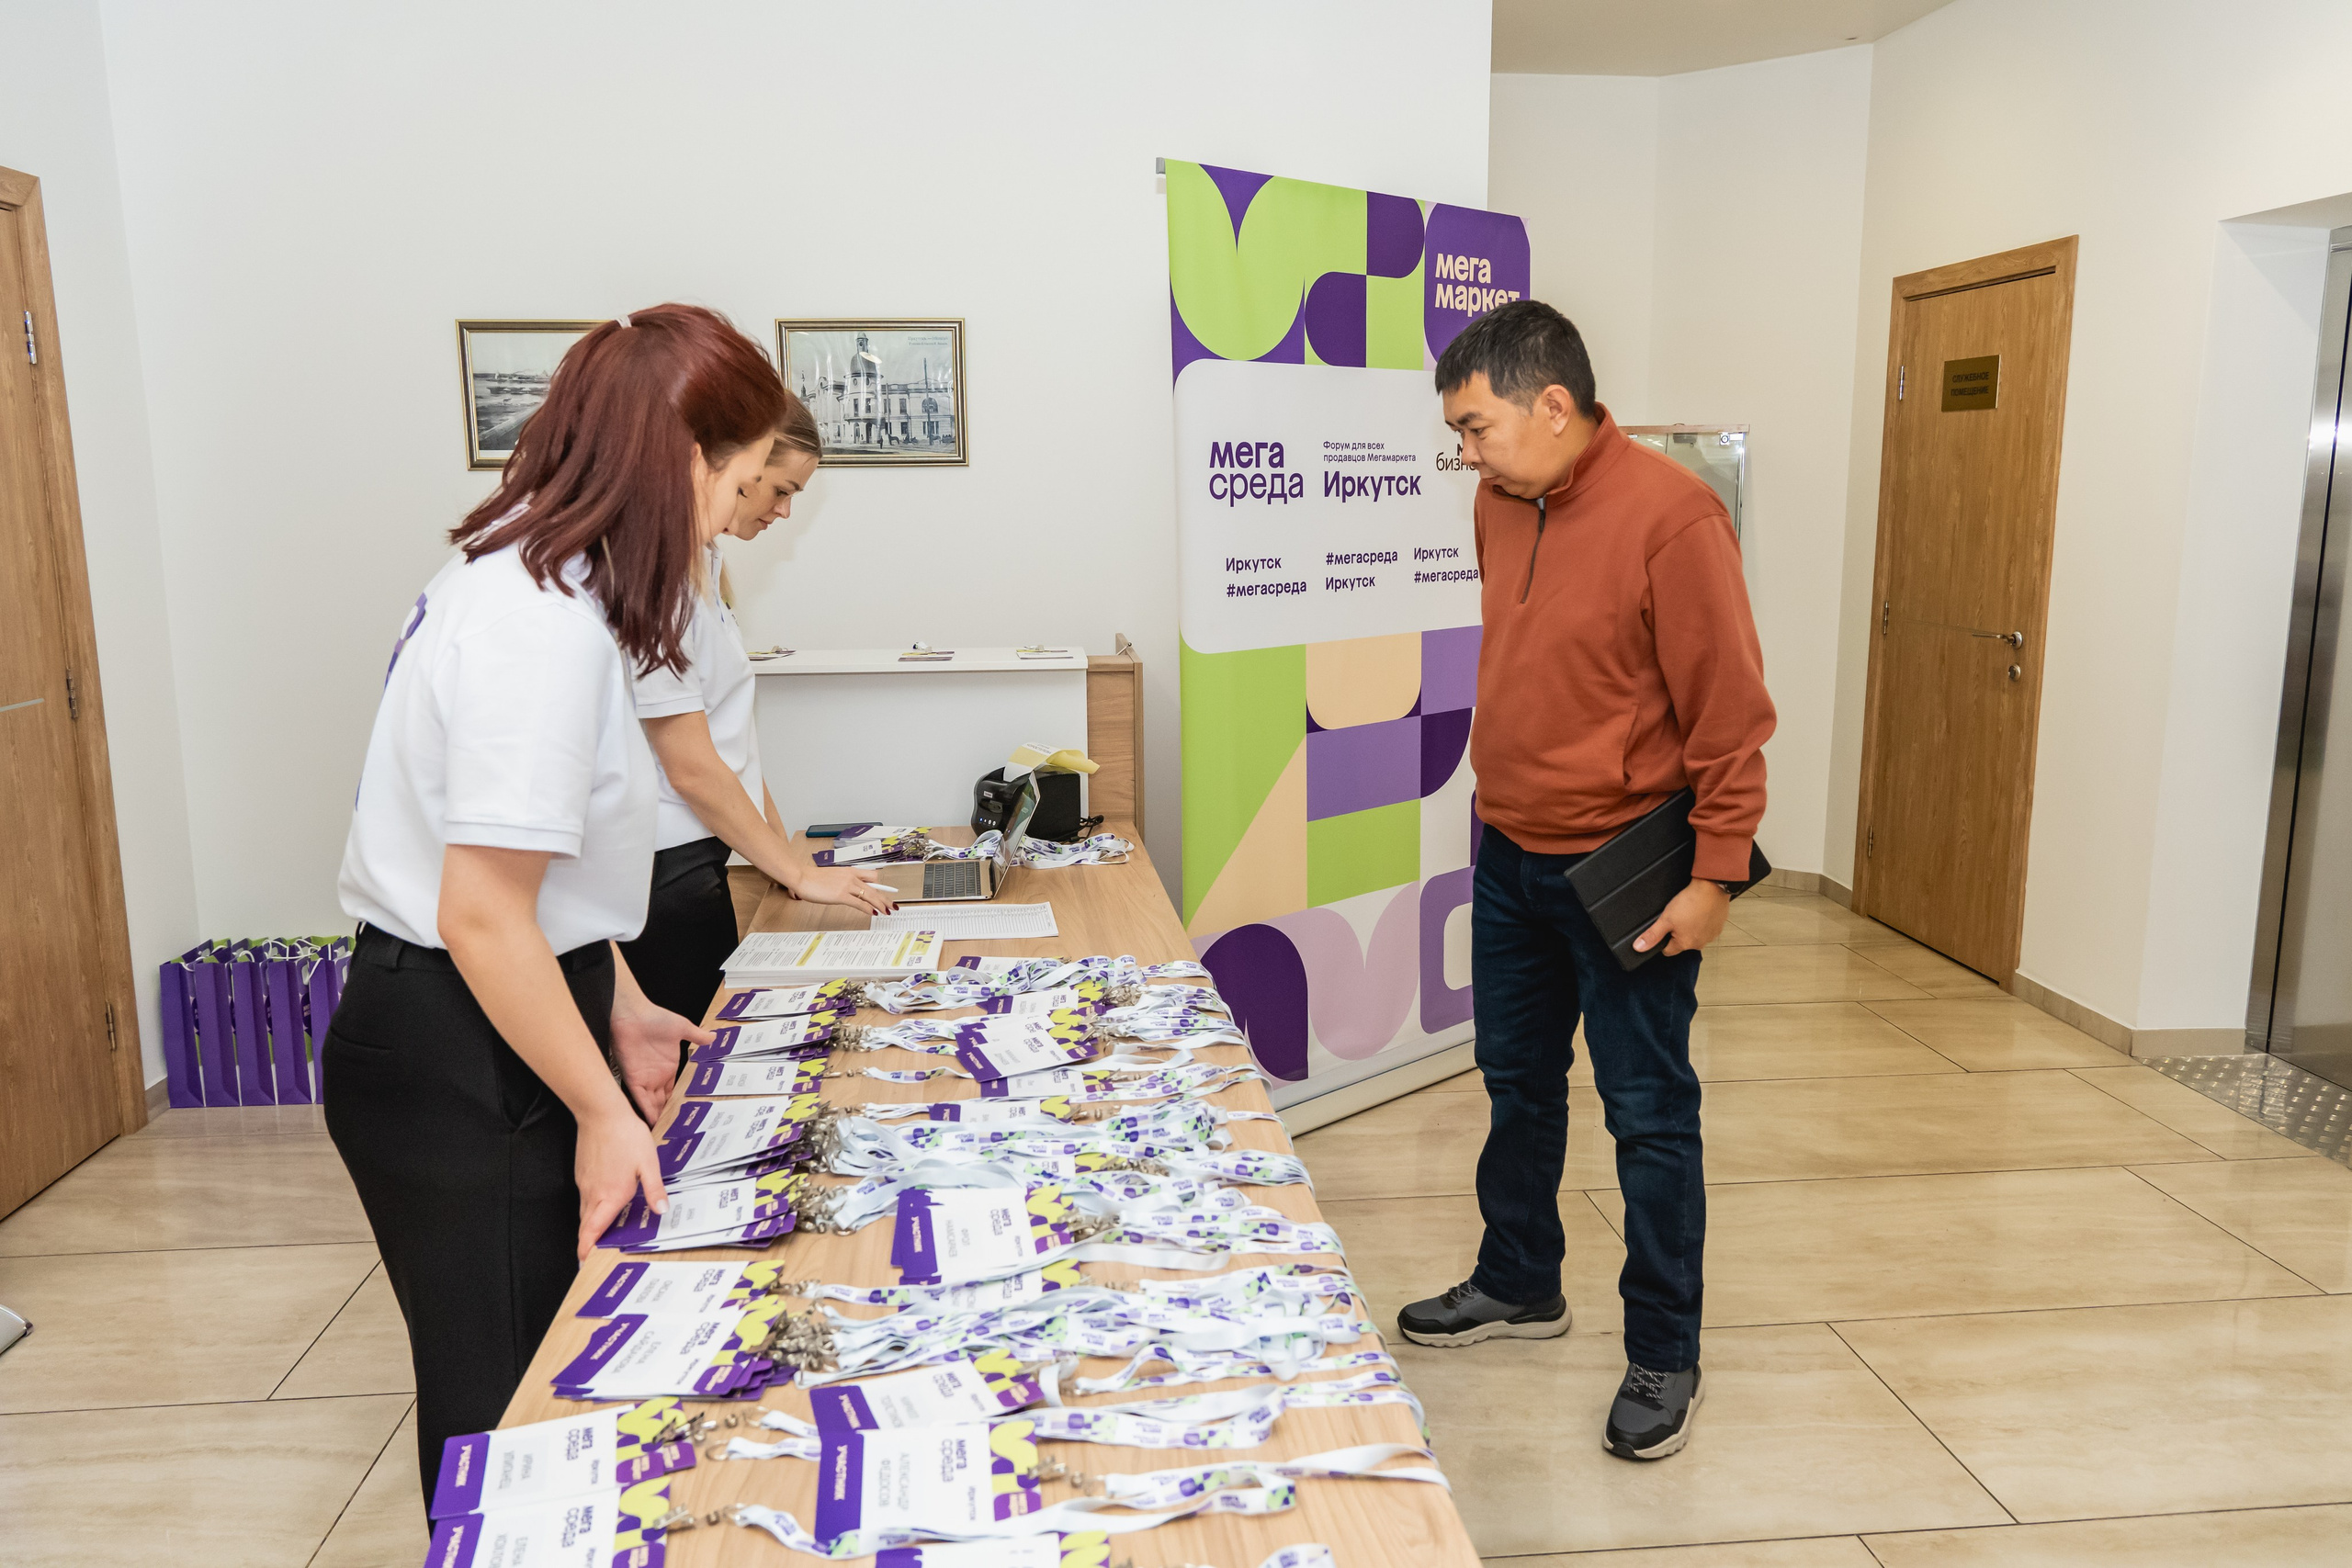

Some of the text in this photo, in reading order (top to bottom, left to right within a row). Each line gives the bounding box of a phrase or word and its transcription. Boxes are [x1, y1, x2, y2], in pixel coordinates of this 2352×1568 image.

[1435, 253, 1491, 284] мега
[1952, 371, 1989, 383] СЛУЖЕБНОЕ
[1951, 386, 1989, 397] ПОМЕЩЕНИЕ
[1323, 441, 1385, 451] Форум для всех
[1209, 441, 1284, 468] мега
[1323, 453, 1417, 463] продавцов Мегамаркета
[1209, 472, 1304, 507] среда
[1324, 470, 1421, 503] Иркутск
[1326, 549, 1398, 566] #мегасреда
[1413, 547, 1459, 561] Иркутск
[1226, 557, 1282, 574] Иркутск
[1326, 576, 1375, 592] Иркутск
[1413, 568, 1479, 584] #мегасреда
[1227, 581, 1307, 598] #мегасреда
